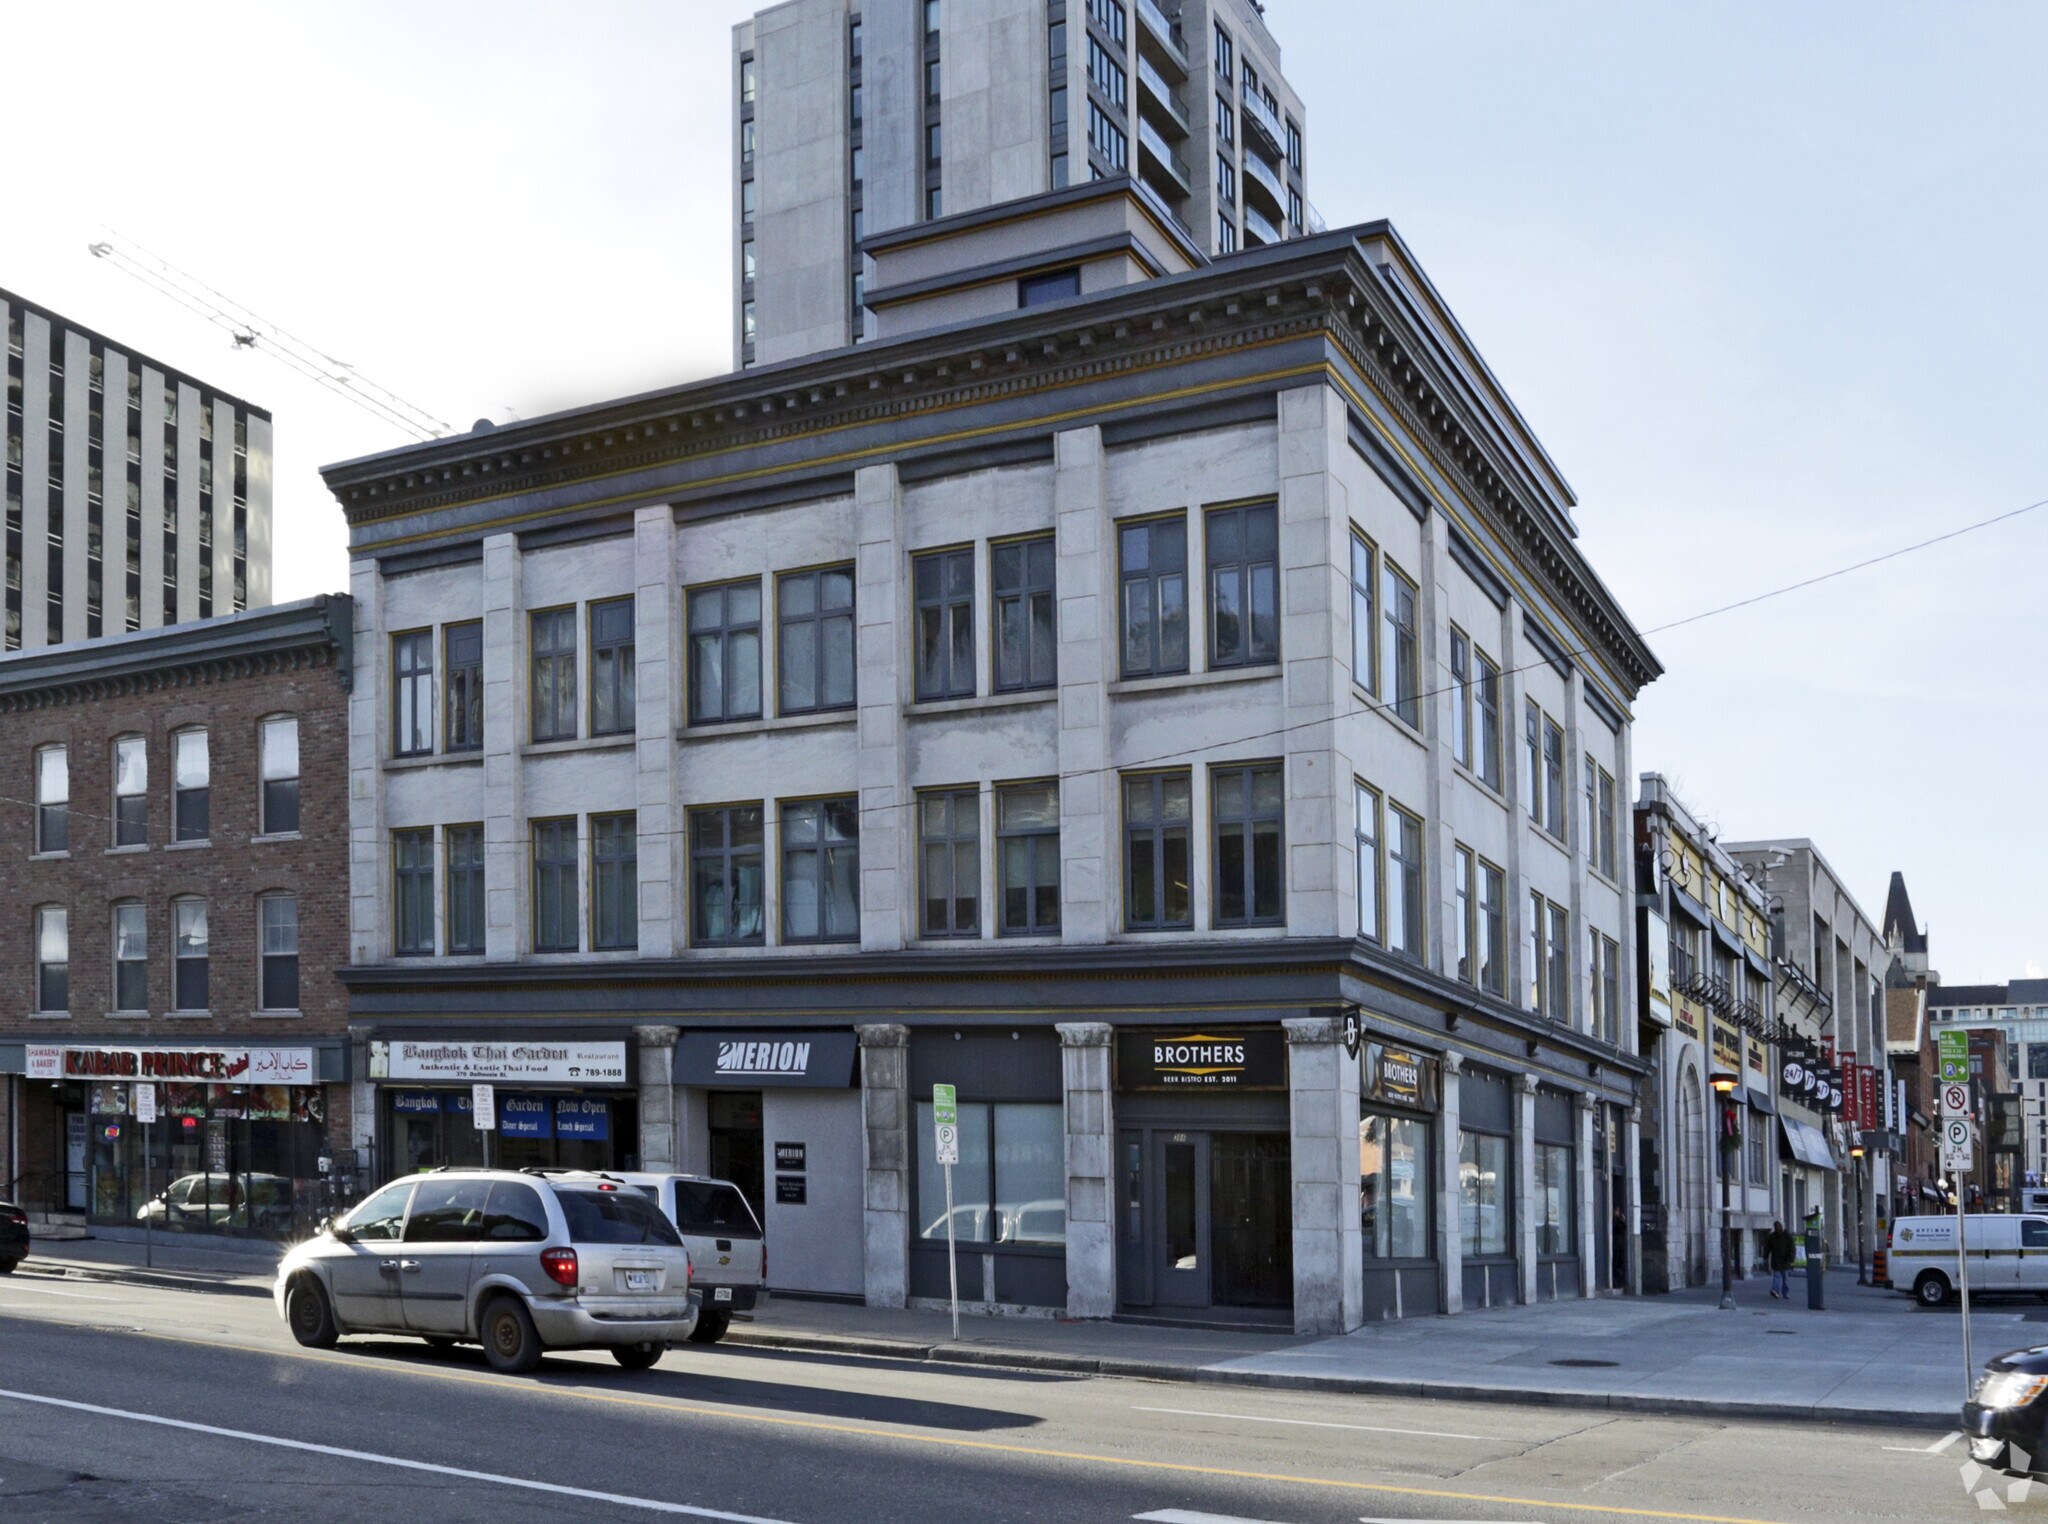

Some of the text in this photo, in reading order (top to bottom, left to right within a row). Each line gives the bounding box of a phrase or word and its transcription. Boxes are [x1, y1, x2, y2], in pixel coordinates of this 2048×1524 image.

[403, 1043, 568, 1061] Bangkok Thai Garden
[717, 1041, 810, 1071] MERION
[1154, 1045, 1245, 1063] BROTHERS
[36, 1059, 56, 1068] BAKERY
[65, 1050, 226, 1078] KABAB PRINCE
[585, 1068, 622, 1077] 789-1888
[1384, 1061, 1417, 1086] BROTHERS
[1785, 1067, 1803, 1081] 24/7
[395, 1096, 544, 1113] Bangkok Th Garden
[556, 1100, 606, 1115] Now Open
[518, 1121, 538, 1131] Special
[574, 1122, 594, 1132] Special
[777, 1148, 804, 1158] MERION
